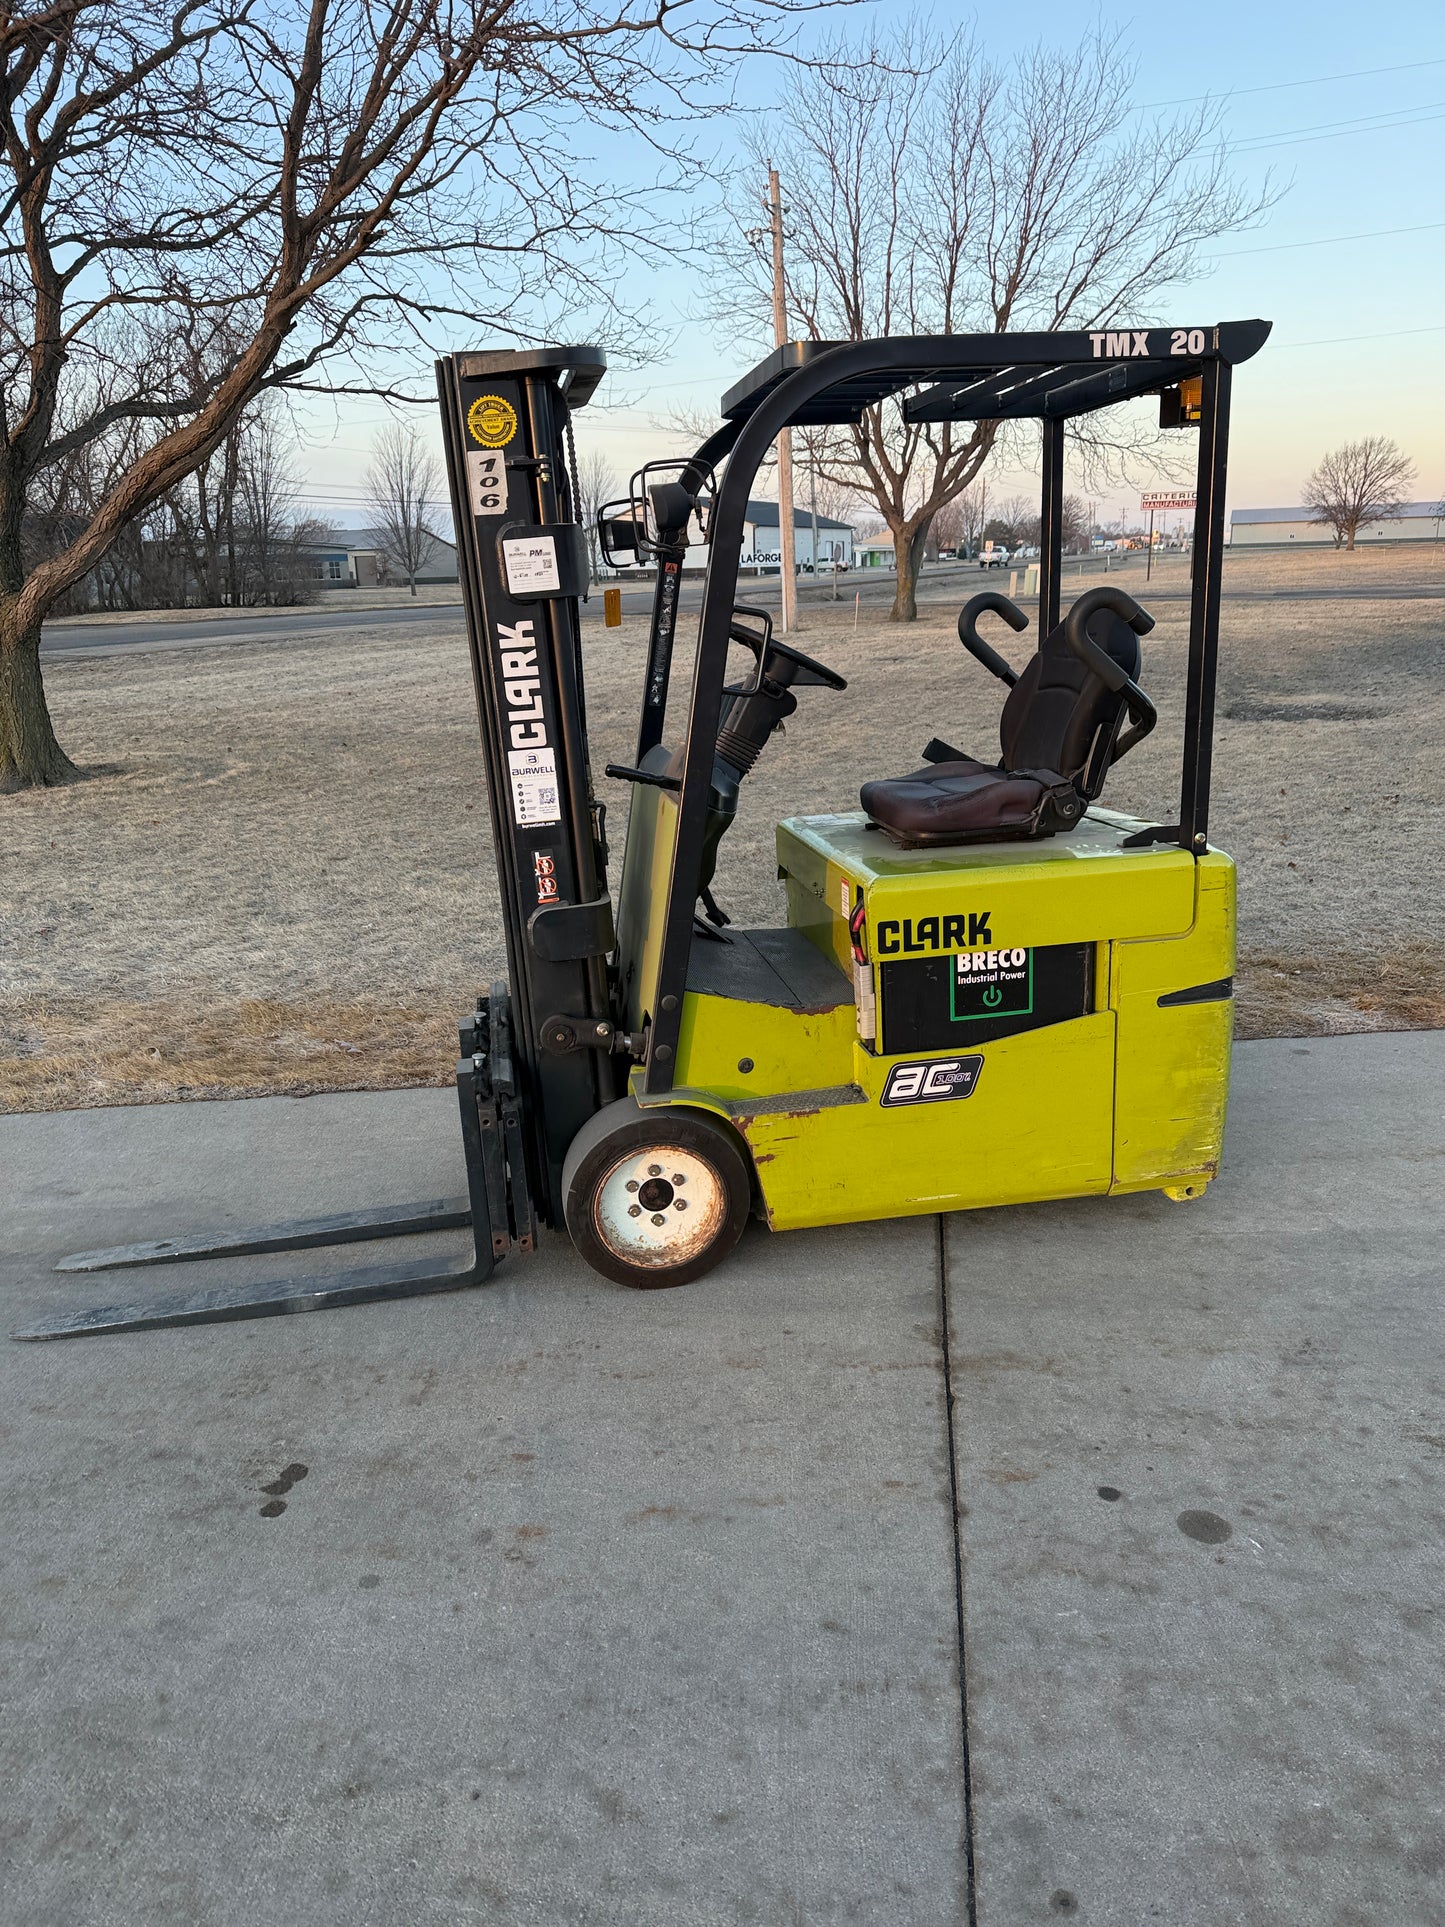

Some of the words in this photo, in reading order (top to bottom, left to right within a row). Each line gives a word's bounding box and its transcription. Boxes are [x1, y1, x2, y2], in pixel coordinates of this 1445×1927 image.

[1089, 332, 1149, 358] TMX
[1170, 329, 1205, 355] 20
[530, 549, 543, 557] PM
[497, 620, 547, 748] CLARK
[512, 766, 555, 776] BURWELL
[877, 911, 992, 955] CLARK
[957, 948, 1026, 973] BRECO
[958, 971, 998, 985] Industrial
[1000, 971, 1026, 981] Power
